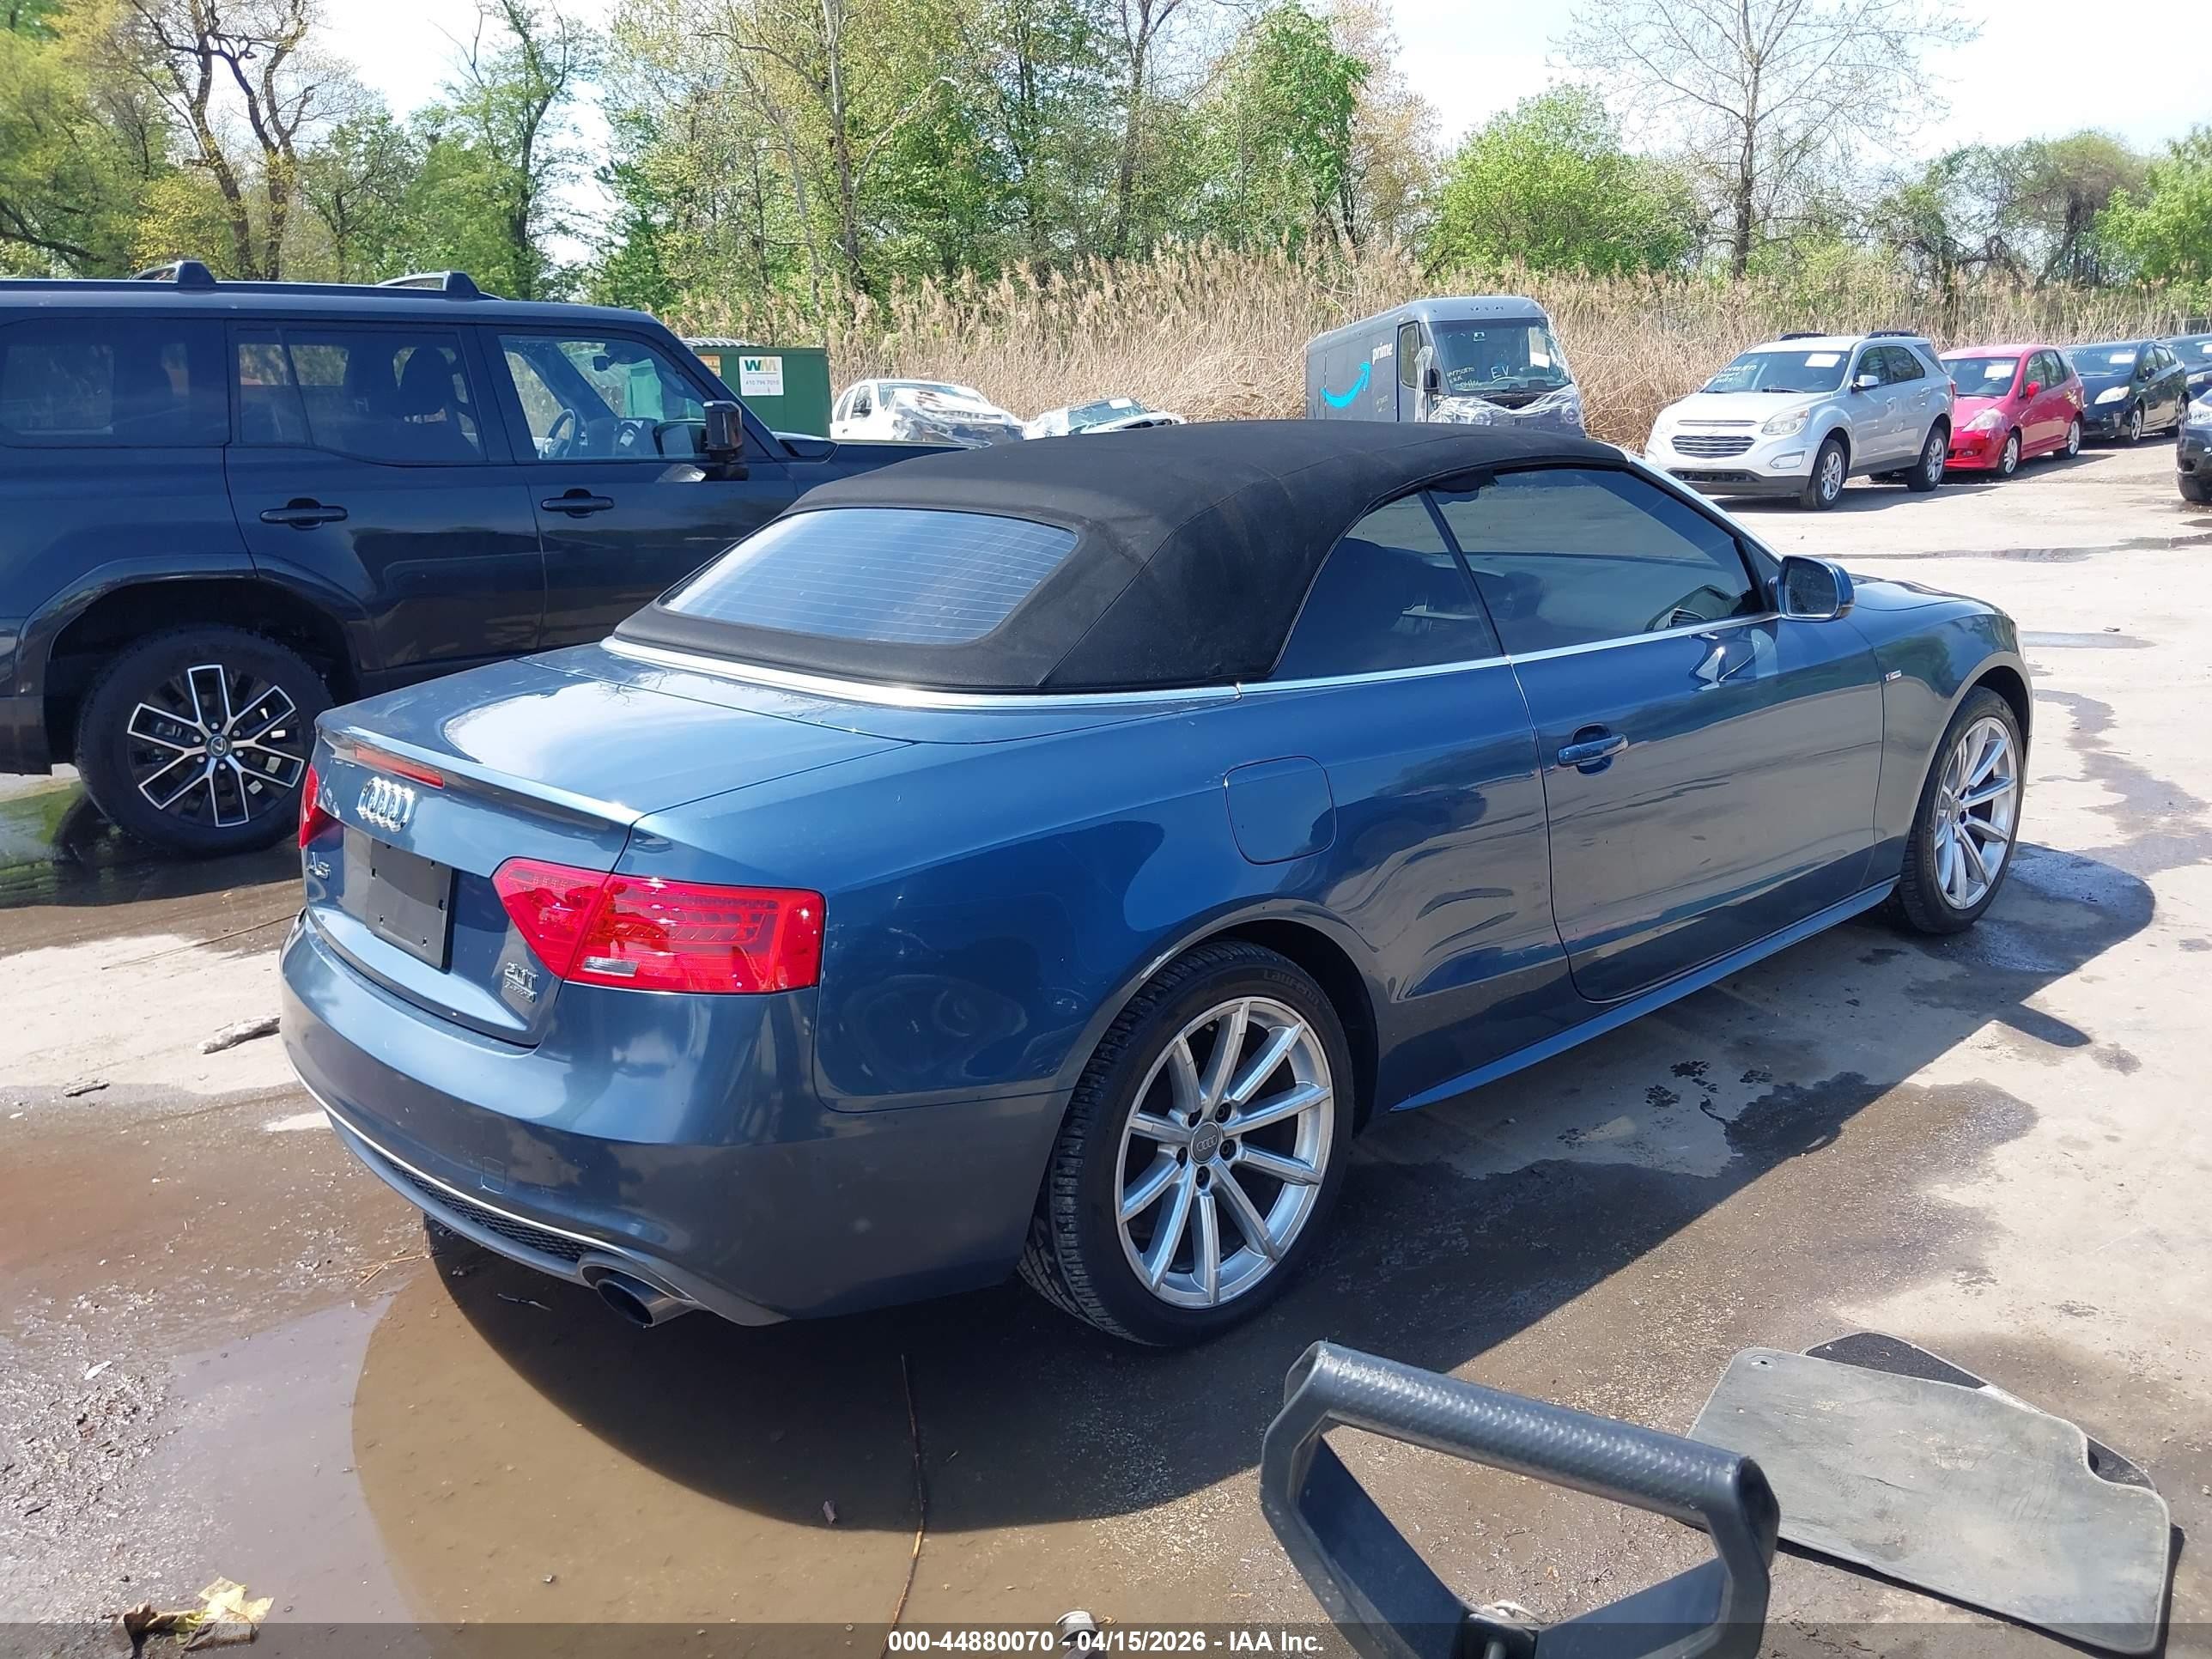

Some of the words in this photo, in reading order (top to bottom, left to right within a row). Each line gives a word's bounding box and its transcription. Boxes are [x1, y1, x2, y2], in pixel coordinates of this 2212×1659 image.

[1371, 342, 1393, 365] prime
[744, 359, 778, 372] WM
[1490, 365, 1510, 380] EV
